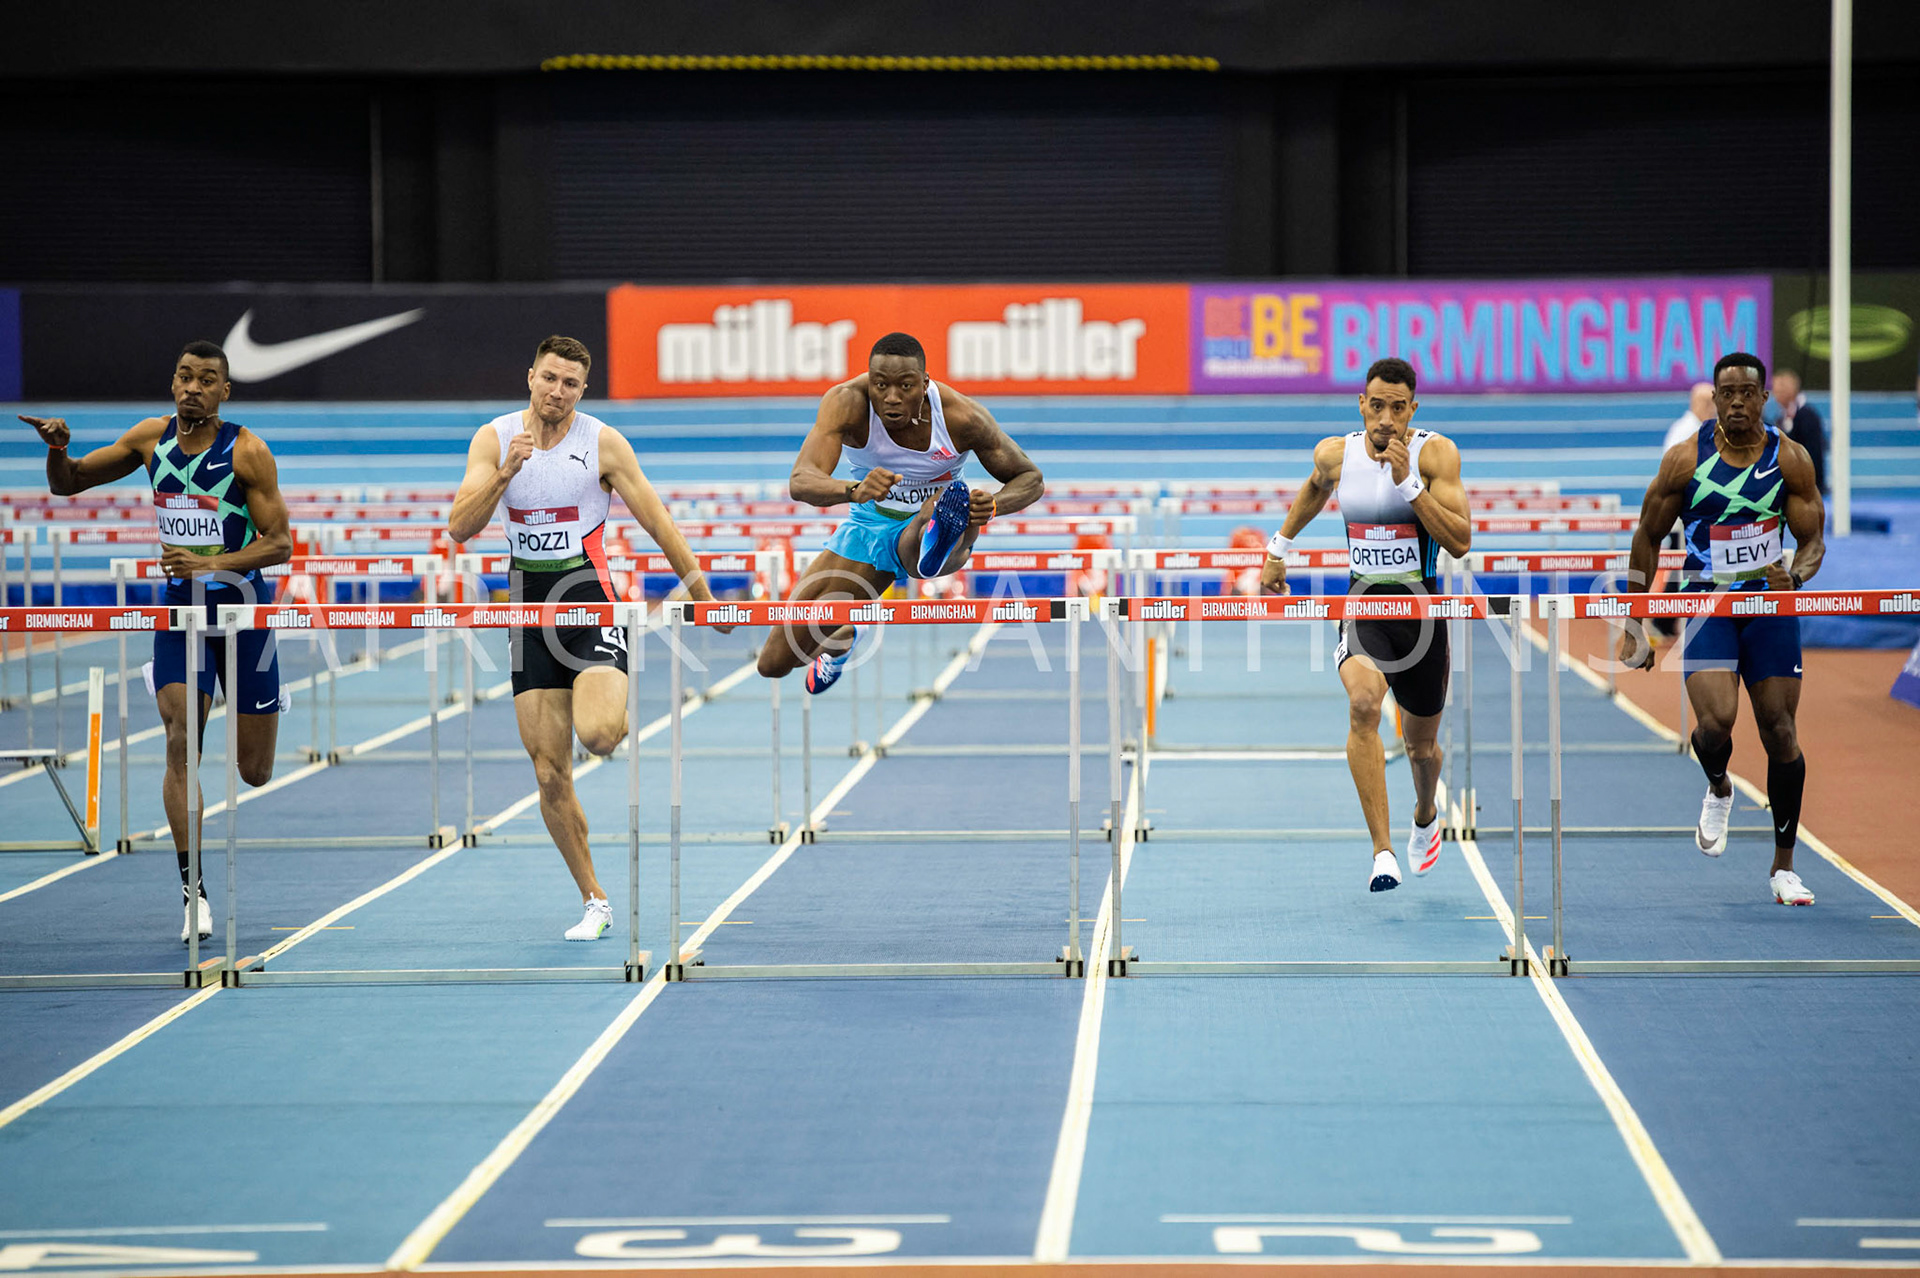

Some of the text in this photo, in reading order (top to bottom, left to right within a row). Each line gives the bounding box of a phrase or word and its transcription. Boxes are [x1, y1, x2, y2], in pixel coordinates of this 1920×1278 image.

[1251, 292, 1322, 358] BE
[657, 298, 857, 384] müller
[948, 297, 1146, 382] müller
[1329, 298, 1758, 384] BIRMINGHAM
[166, 495, 199, 509] müller
[159, 515, 221, 537] ALYOUHA
[523, 510, 558, 525] müller
[518, 531, 570, 552] POZZI
[1365, 526, 1398, 541] müller
[1731, 523, 1765, 540] müller
[711, 555, 747, 571] müller
[1352, 546, 1418, 566] ORTEGA
[1725, 540, 1770, 565] LEVY
[305, 561, 356, 574] BIRMINGHAM
[368, 559, 404, 575] müller
[1492, 556, 1530, 571] müller
[707, 602, 1038, 624] müller BIRMINGHAM müller BIRMINGHAM müller
[1140, 599, 1475, 620] müller BIRMINGHAM müller BIRMINGHAM müller
[1585, 593, 1920, 617] müller BIRMINGHAM müller BIRMINGHAM mülle
[26, 613, 93, 628] BIRMINGHAM
[110, 610, 157, 630] müller
[266, 607, 601, 628] müller BIRMINGHAM müller BIRMINGHAM müller
